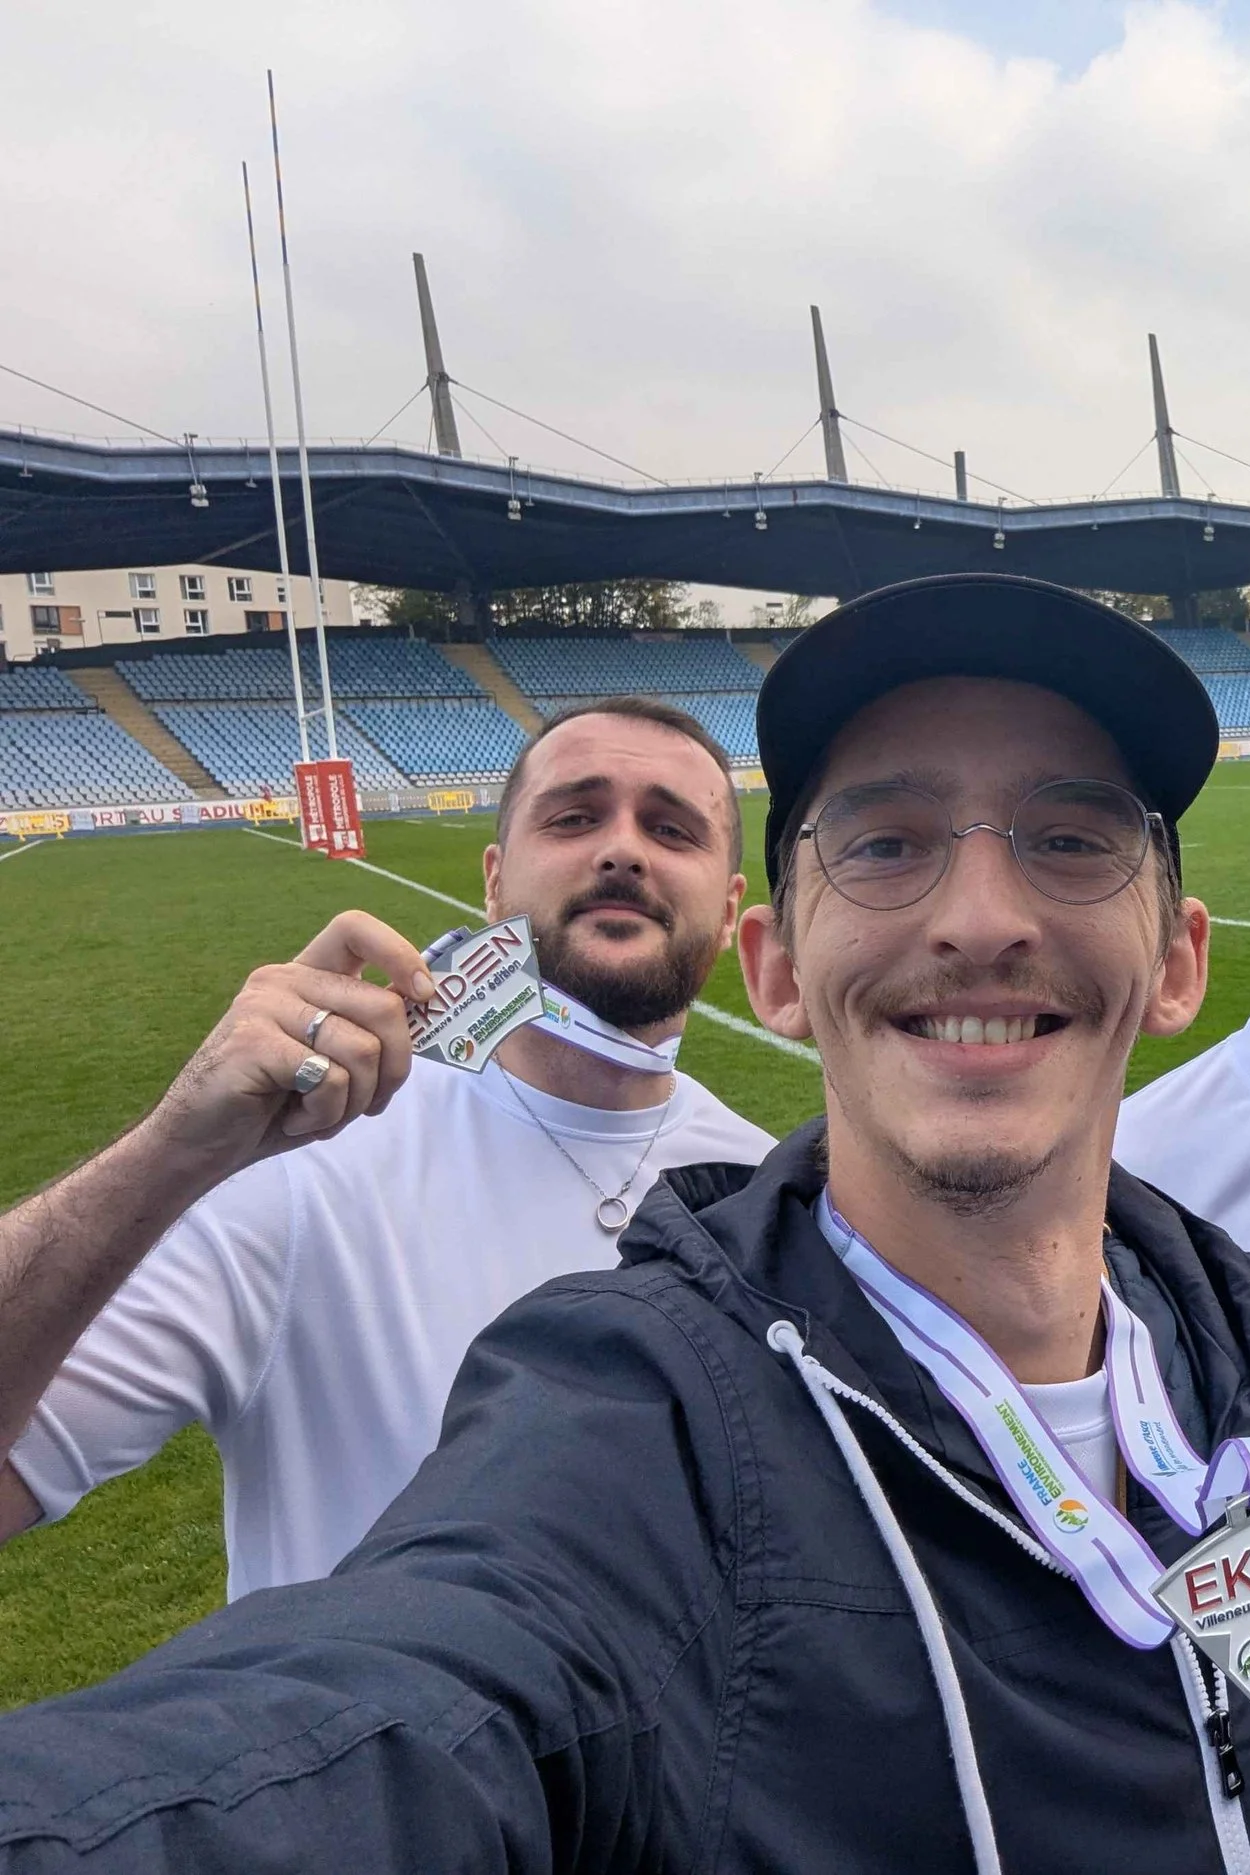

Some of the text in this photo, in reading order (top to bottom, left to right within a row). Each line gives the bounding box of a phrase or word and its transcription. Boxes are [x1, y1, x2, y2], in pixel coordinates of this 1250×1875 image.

[328, 773, 345, 829] MÉTROPOLE
[487, 958, 522, 991] édition
[467, 1006, 498, 1035] FRANCE
[473, 985, 533, 1042] ENVIRONNEMENT
[995, 1403, 1062, 1499] ENVIRONNEMENT
[1017, 1459, 1053, 1507] FRANCE
